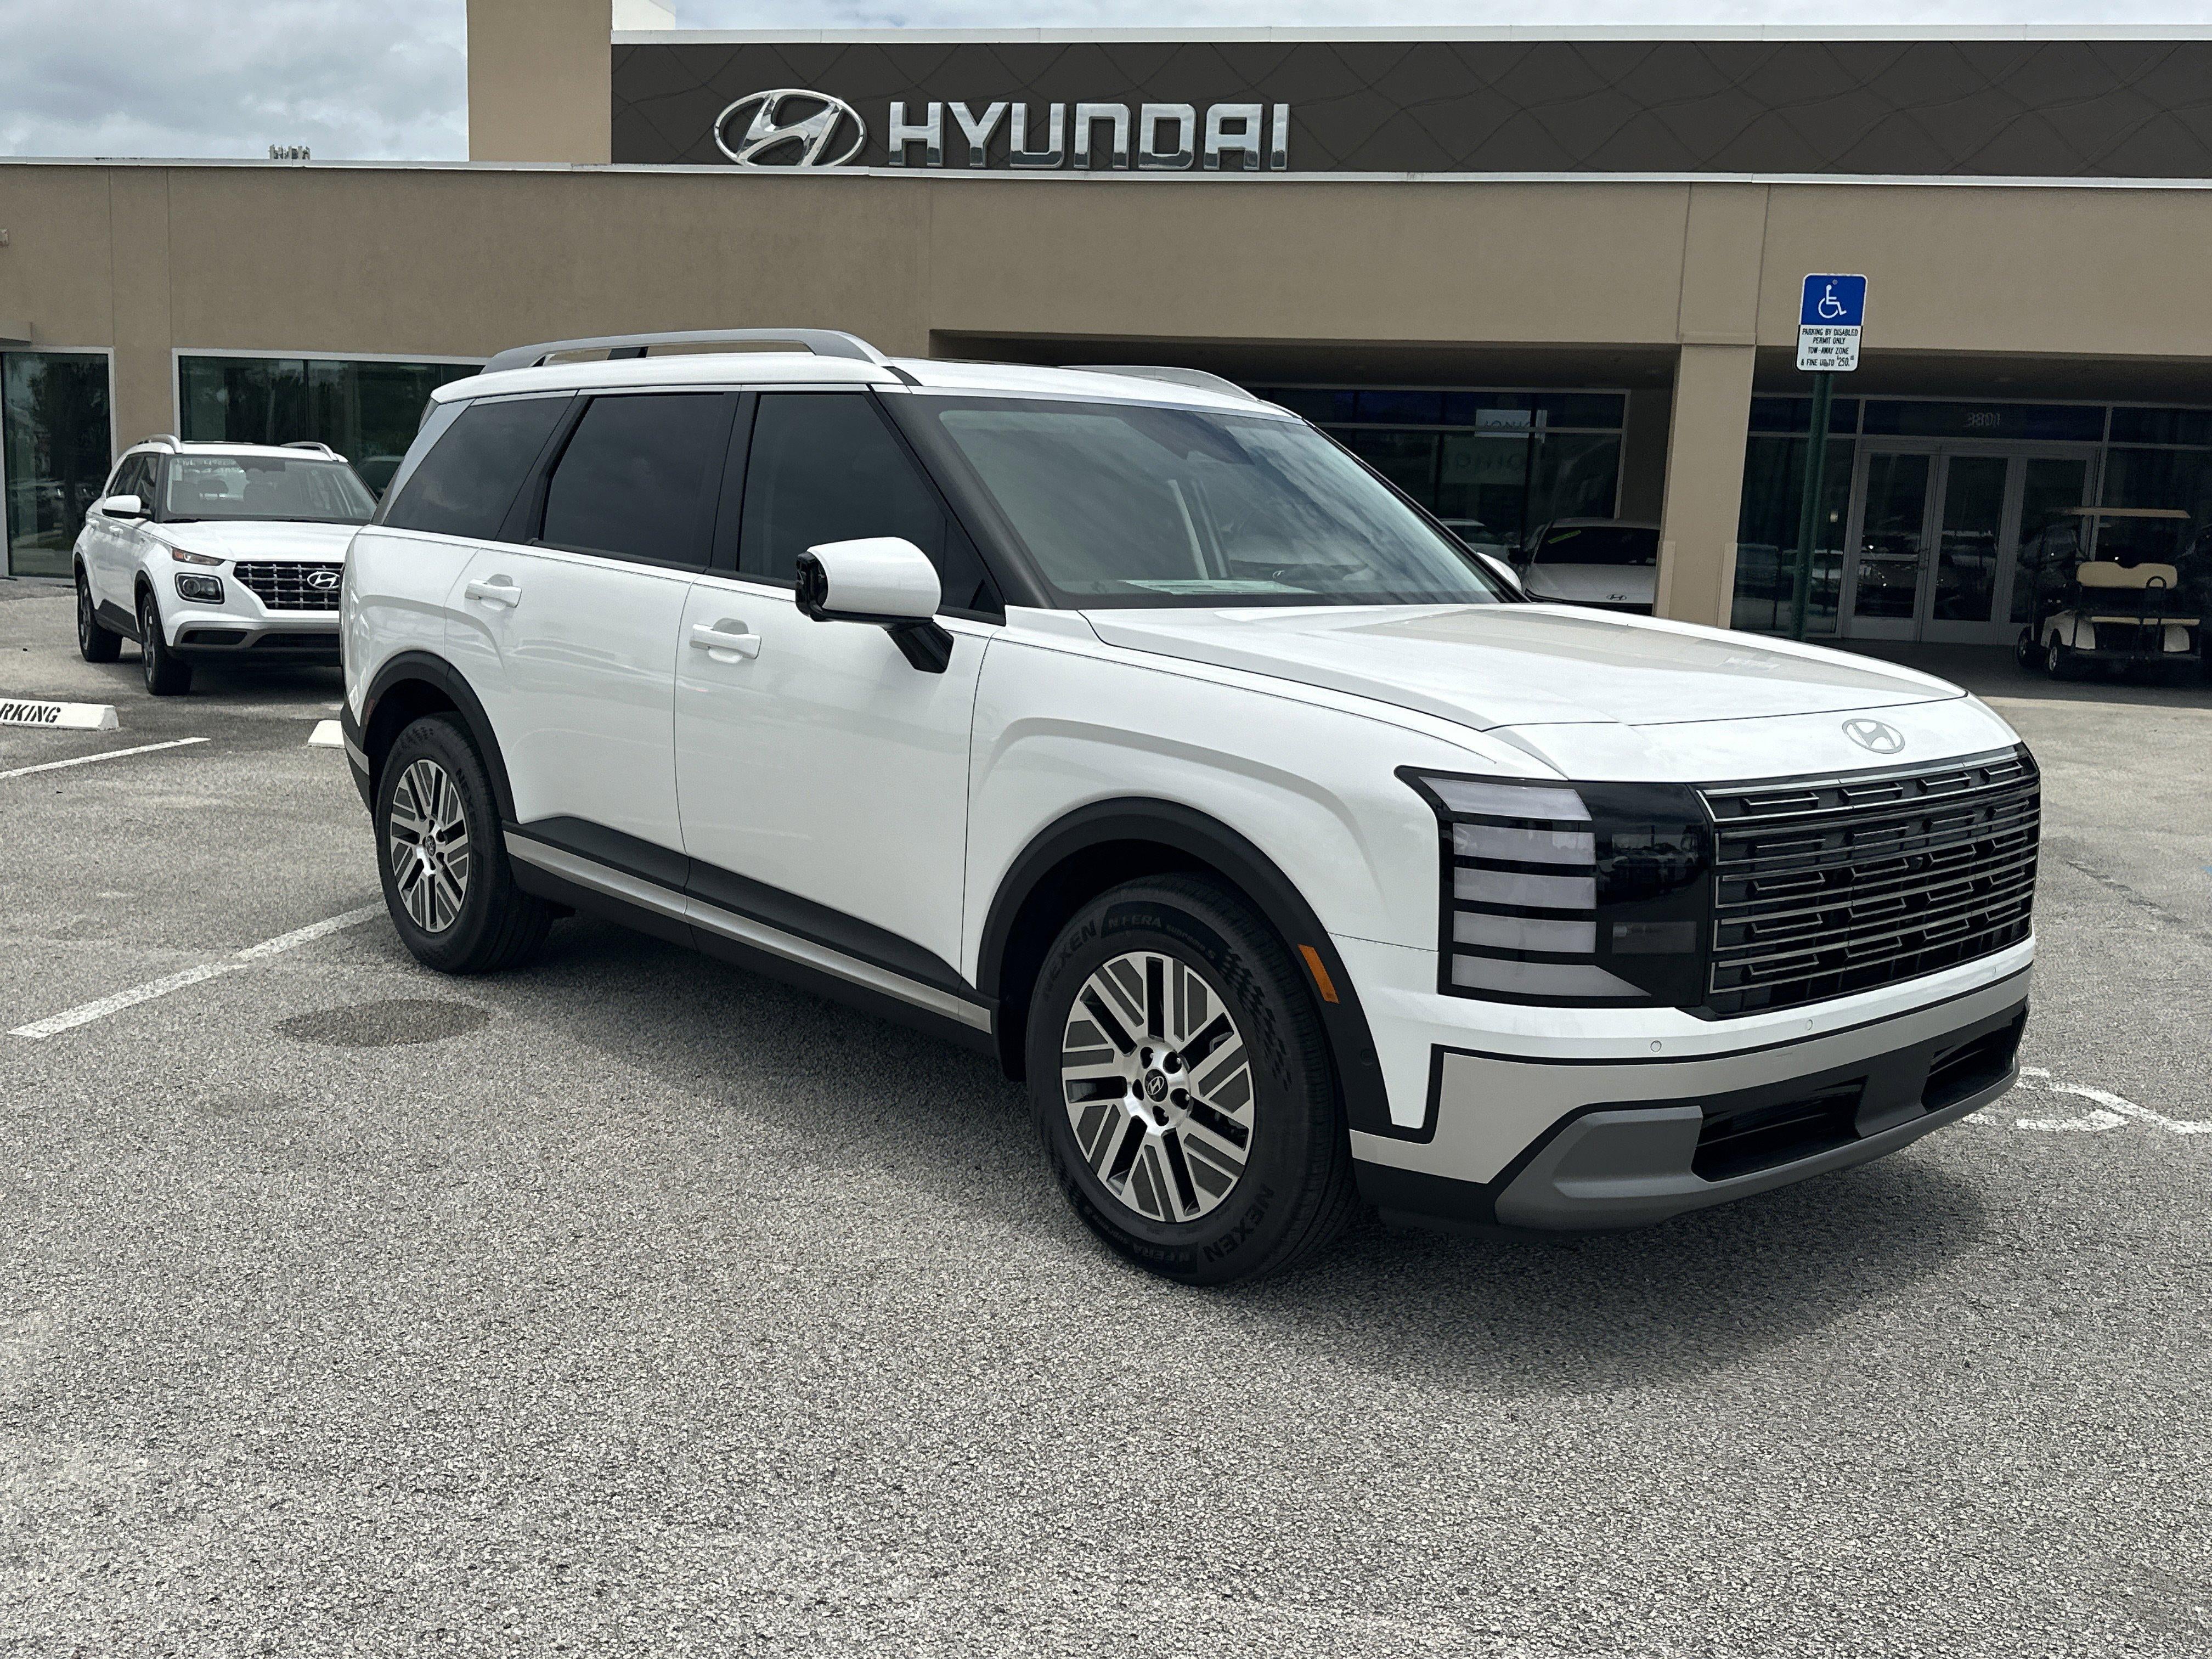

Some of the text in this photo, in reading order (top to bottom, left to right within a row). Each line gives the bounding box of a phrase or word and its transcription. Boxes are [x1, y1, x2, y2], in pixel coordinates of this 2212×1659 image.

[889, 101, 1289, 171] HYUNDAI
[0, 703, 61, 723] RKING
[1203, 1182, 1275, 1263] NEXEN
